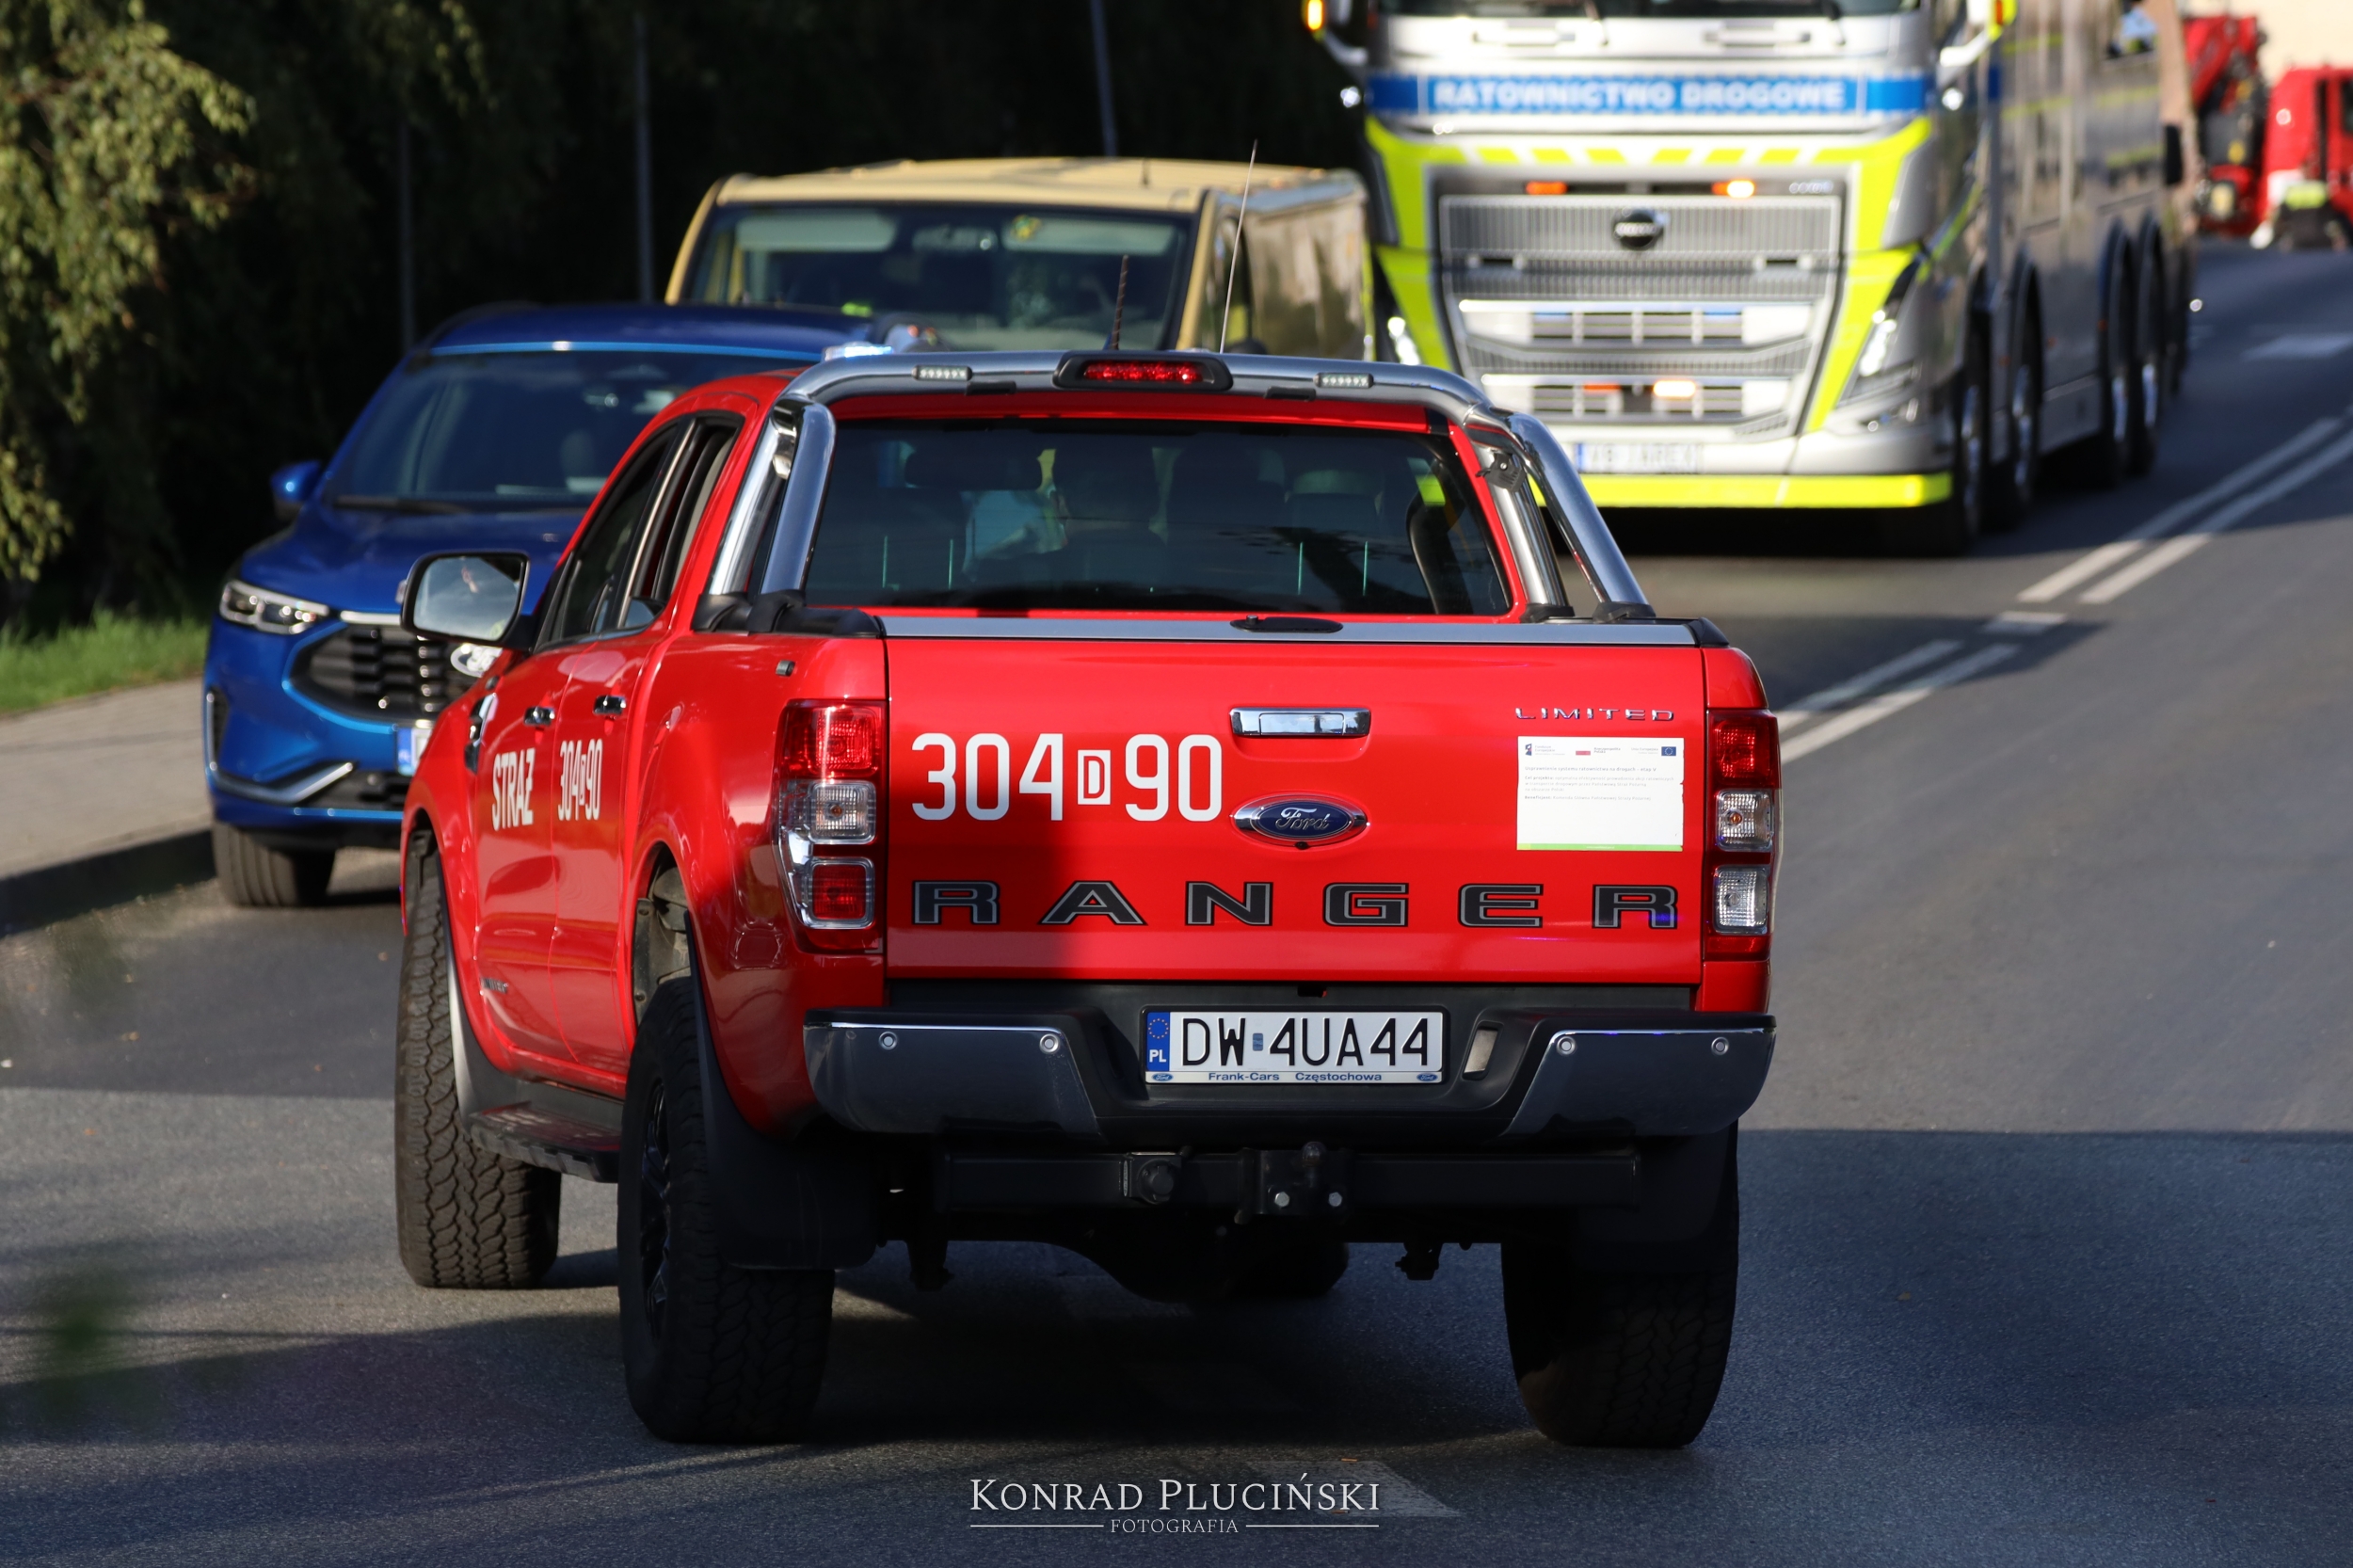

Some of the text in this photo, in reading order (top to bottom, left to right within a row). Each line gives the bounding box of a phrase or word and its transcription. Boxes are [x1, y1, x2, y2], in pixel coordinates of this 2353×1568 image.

[1433, 80, 1847, 110] RATOWNICTWO DROGOWE
[1515, 708, 1674, 721] LIMITED
[1274, 807, 1332, 832] Ford
[911, 879, 1679, 931] RANGER
[1182, 1017, 1429, 1066] DW 4UA44
[1148, 1049, 1167, 1064] PL
[1209, 1071, 1383, 1083] Frank-Cars Częstochowa
